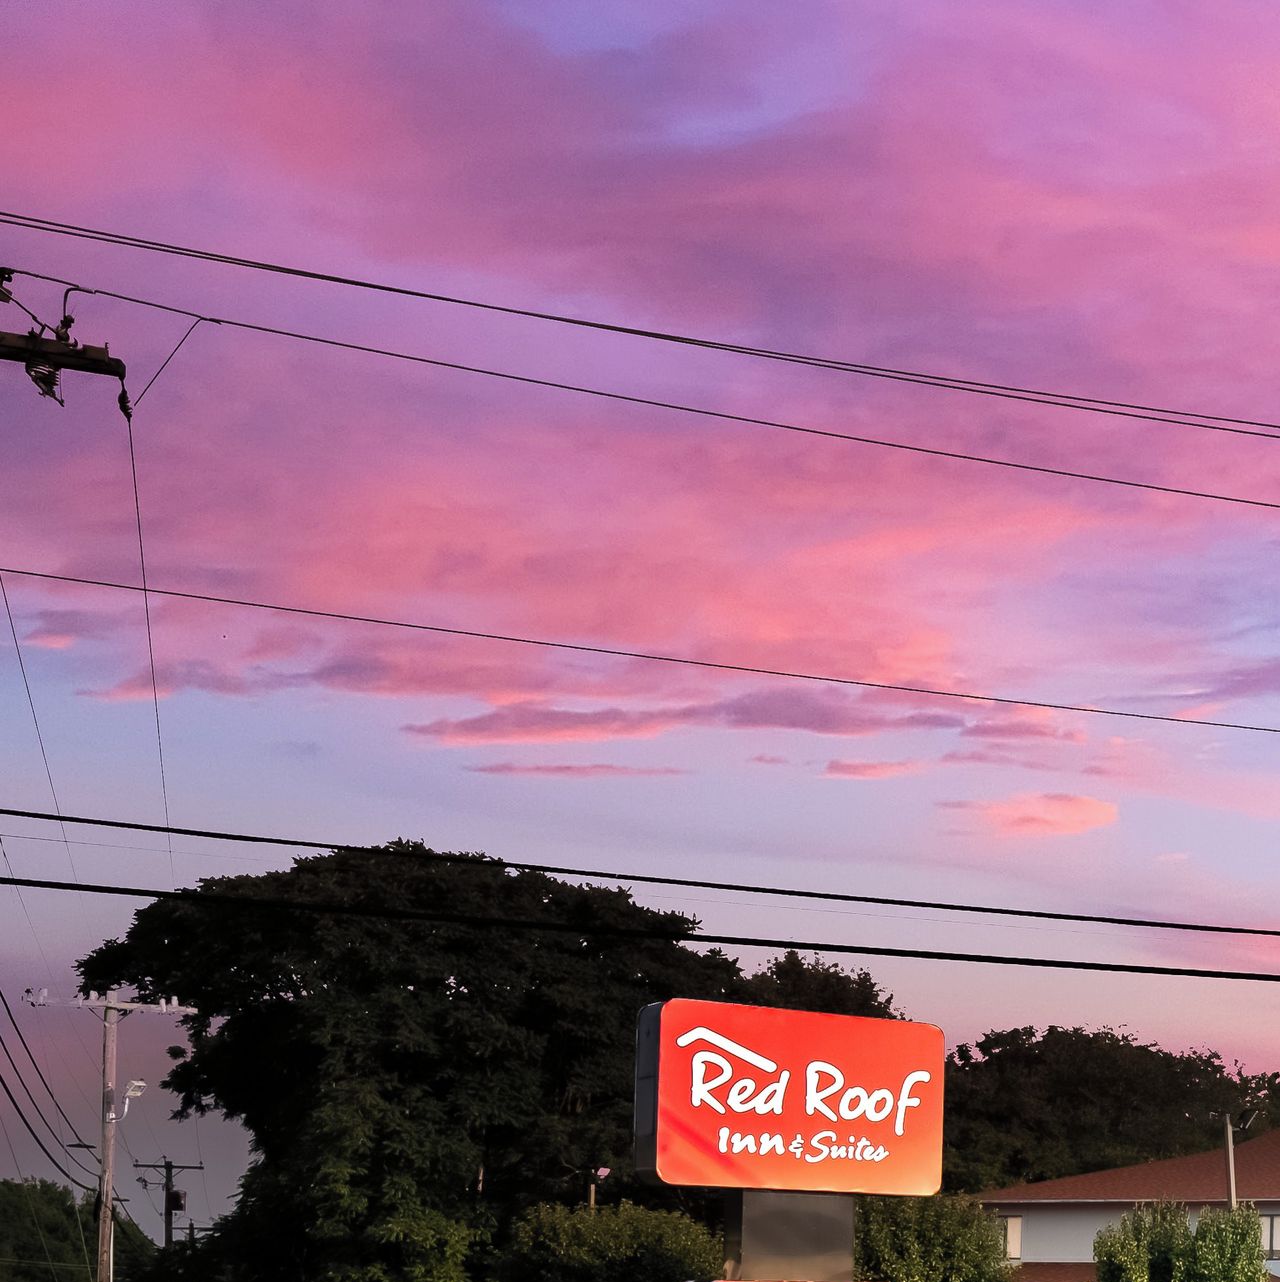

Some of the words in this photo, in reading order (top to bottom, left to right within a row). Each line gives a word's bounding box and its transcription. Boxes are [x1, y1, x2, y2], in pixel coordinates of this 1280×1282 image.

[691, 1050, 791, 1115] Red
[805, 1060, 931, 1136] Roof
[717, 1126, 786, 1155] Inn
[804, 1129, 890, 1163] Suites
